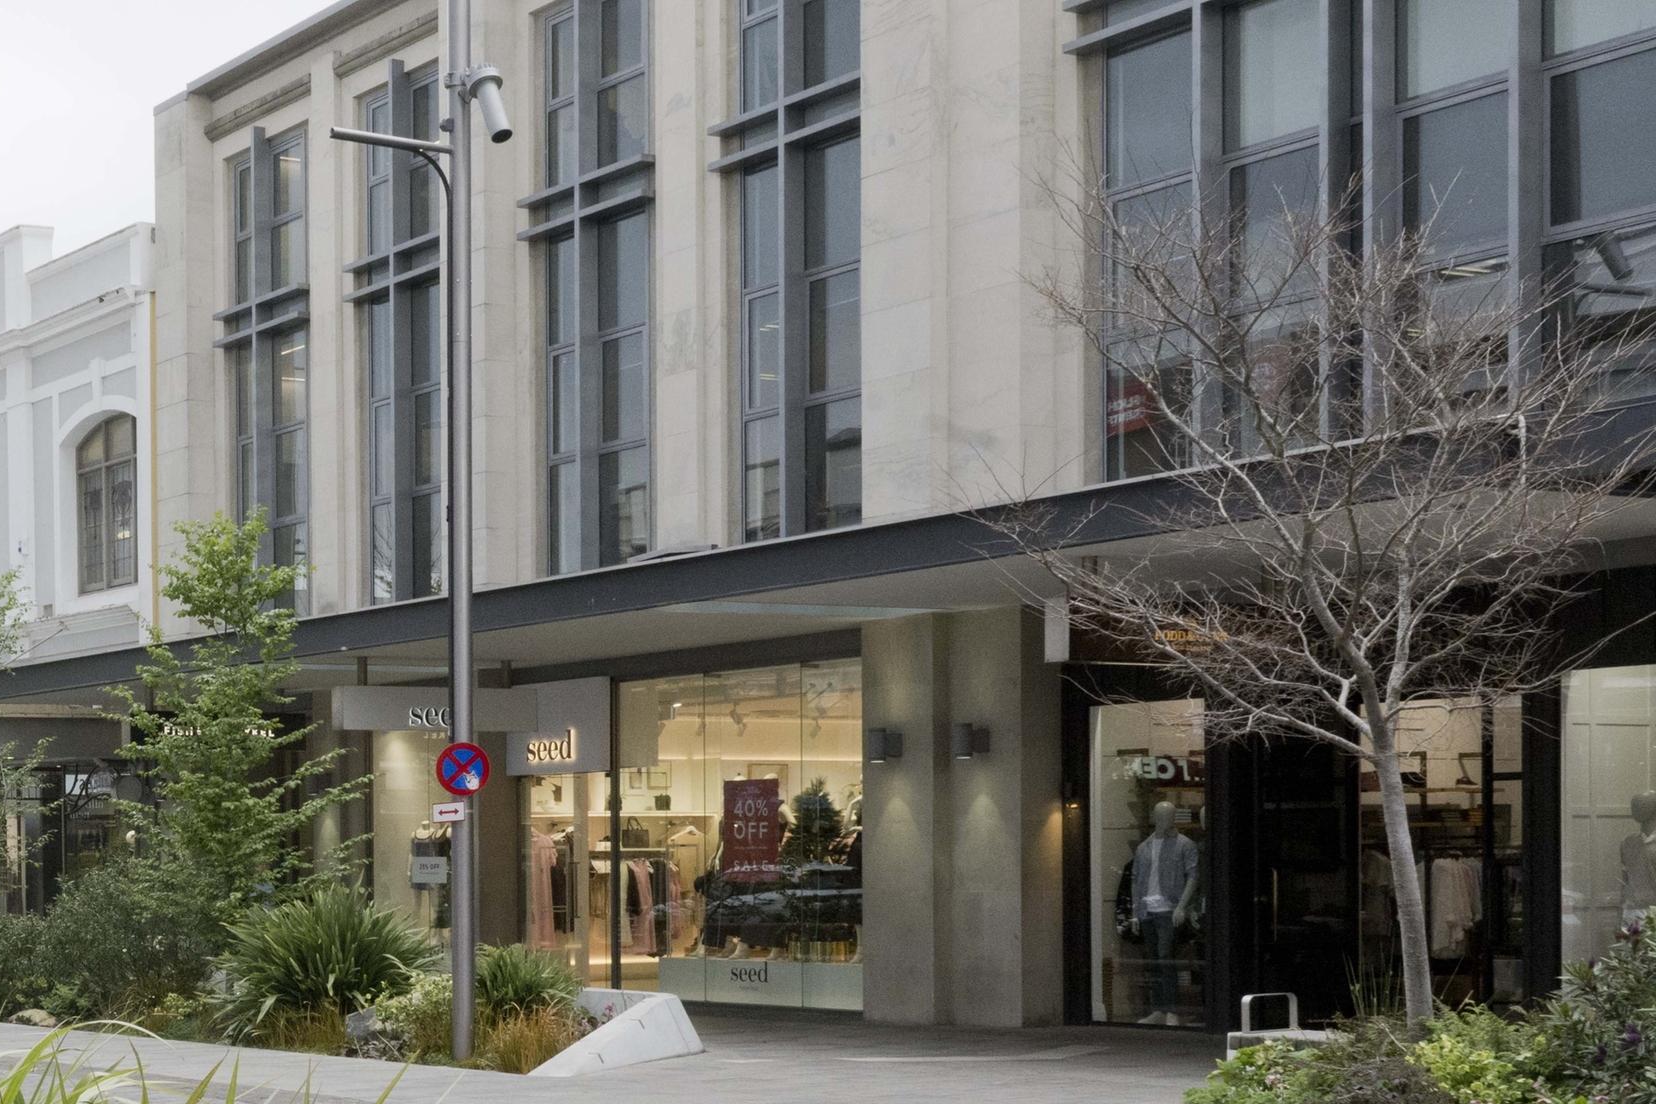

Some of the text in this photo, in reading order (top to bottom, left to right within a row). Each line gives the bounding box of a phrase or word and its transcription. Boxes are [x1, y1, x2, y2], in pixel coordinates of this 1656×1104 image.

[527, 729, 573, 762] seed
[733, 799, 769, 817] 40%
[733, 822, 769, 839] OFF
[730, 961, 769, 984] seed
